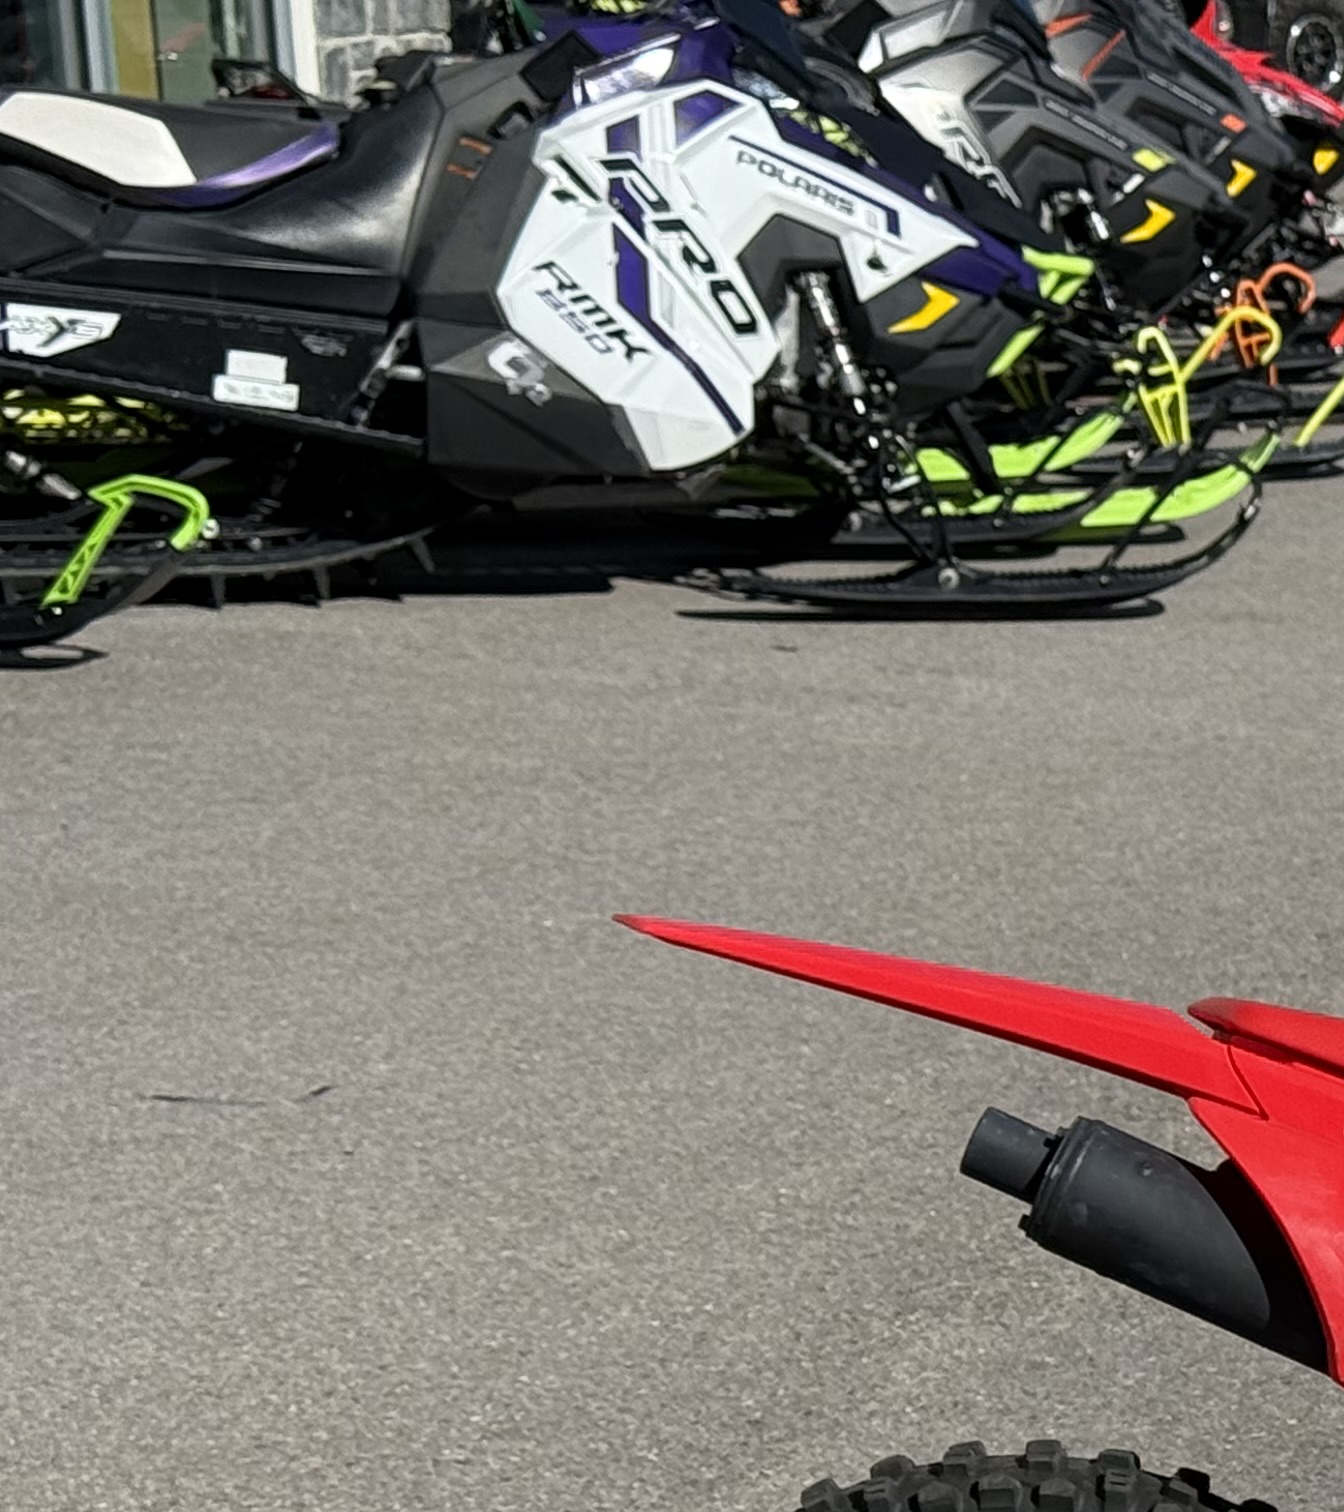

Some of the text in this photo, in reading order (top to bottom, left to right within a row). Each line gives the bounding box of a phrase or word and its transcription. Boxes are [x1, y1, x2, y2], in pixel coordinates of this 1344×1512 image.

[736, 150, 855, 216] POLARIS
[598, 158, 758, 335] PRO
[532, 261, 652, 361] RMK
